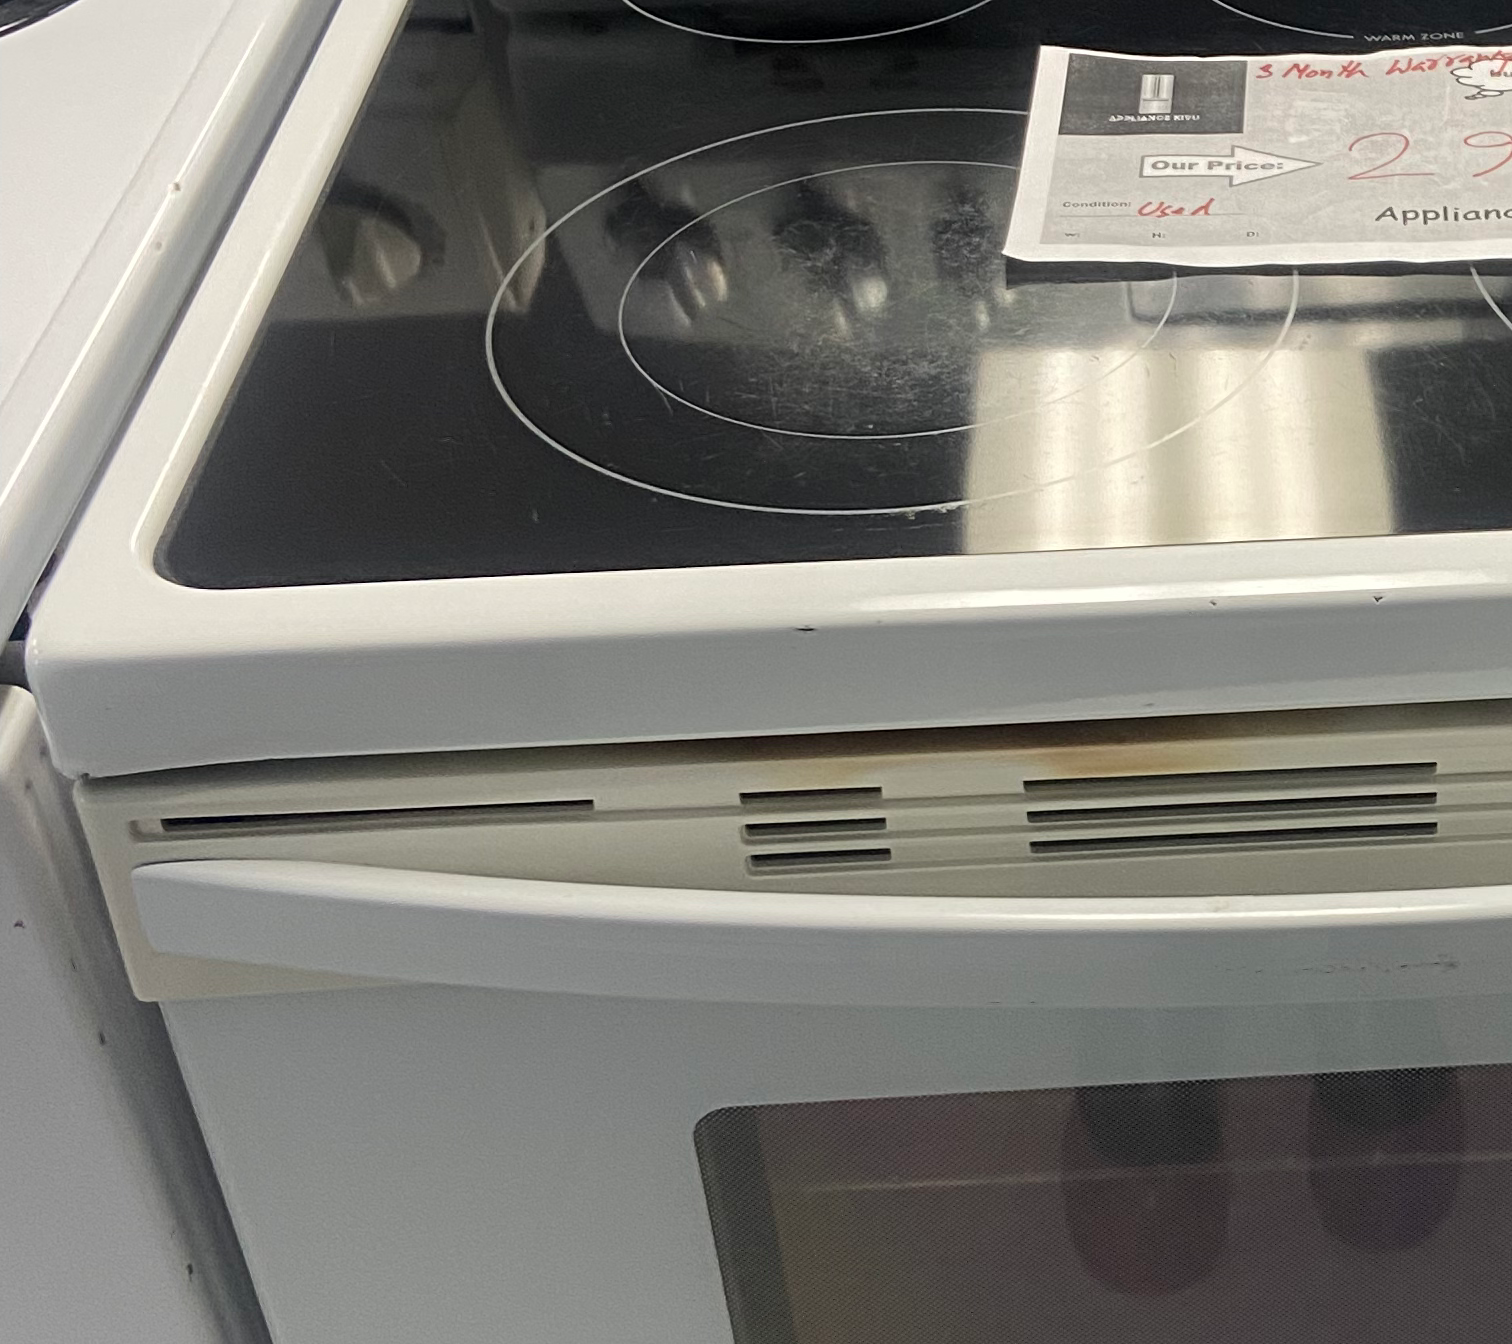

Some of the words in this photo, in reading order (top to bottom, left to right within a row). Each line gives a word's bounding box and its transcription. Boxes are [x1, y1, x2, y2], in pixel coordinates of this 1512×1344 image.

[1364, 33, 1416, 42] WARM
[1420, 32, 1464, 41] ZONE
[1256, 63, 1273, 79] 3
[1282, 61, 1369, 80] Month
[1151, 159, 1200, 171] Our
[1207, 159, 1284, 171] Price:
[1062, 200, 1132, 208] Condition:
[1137, 197, 1215, 218] Used
